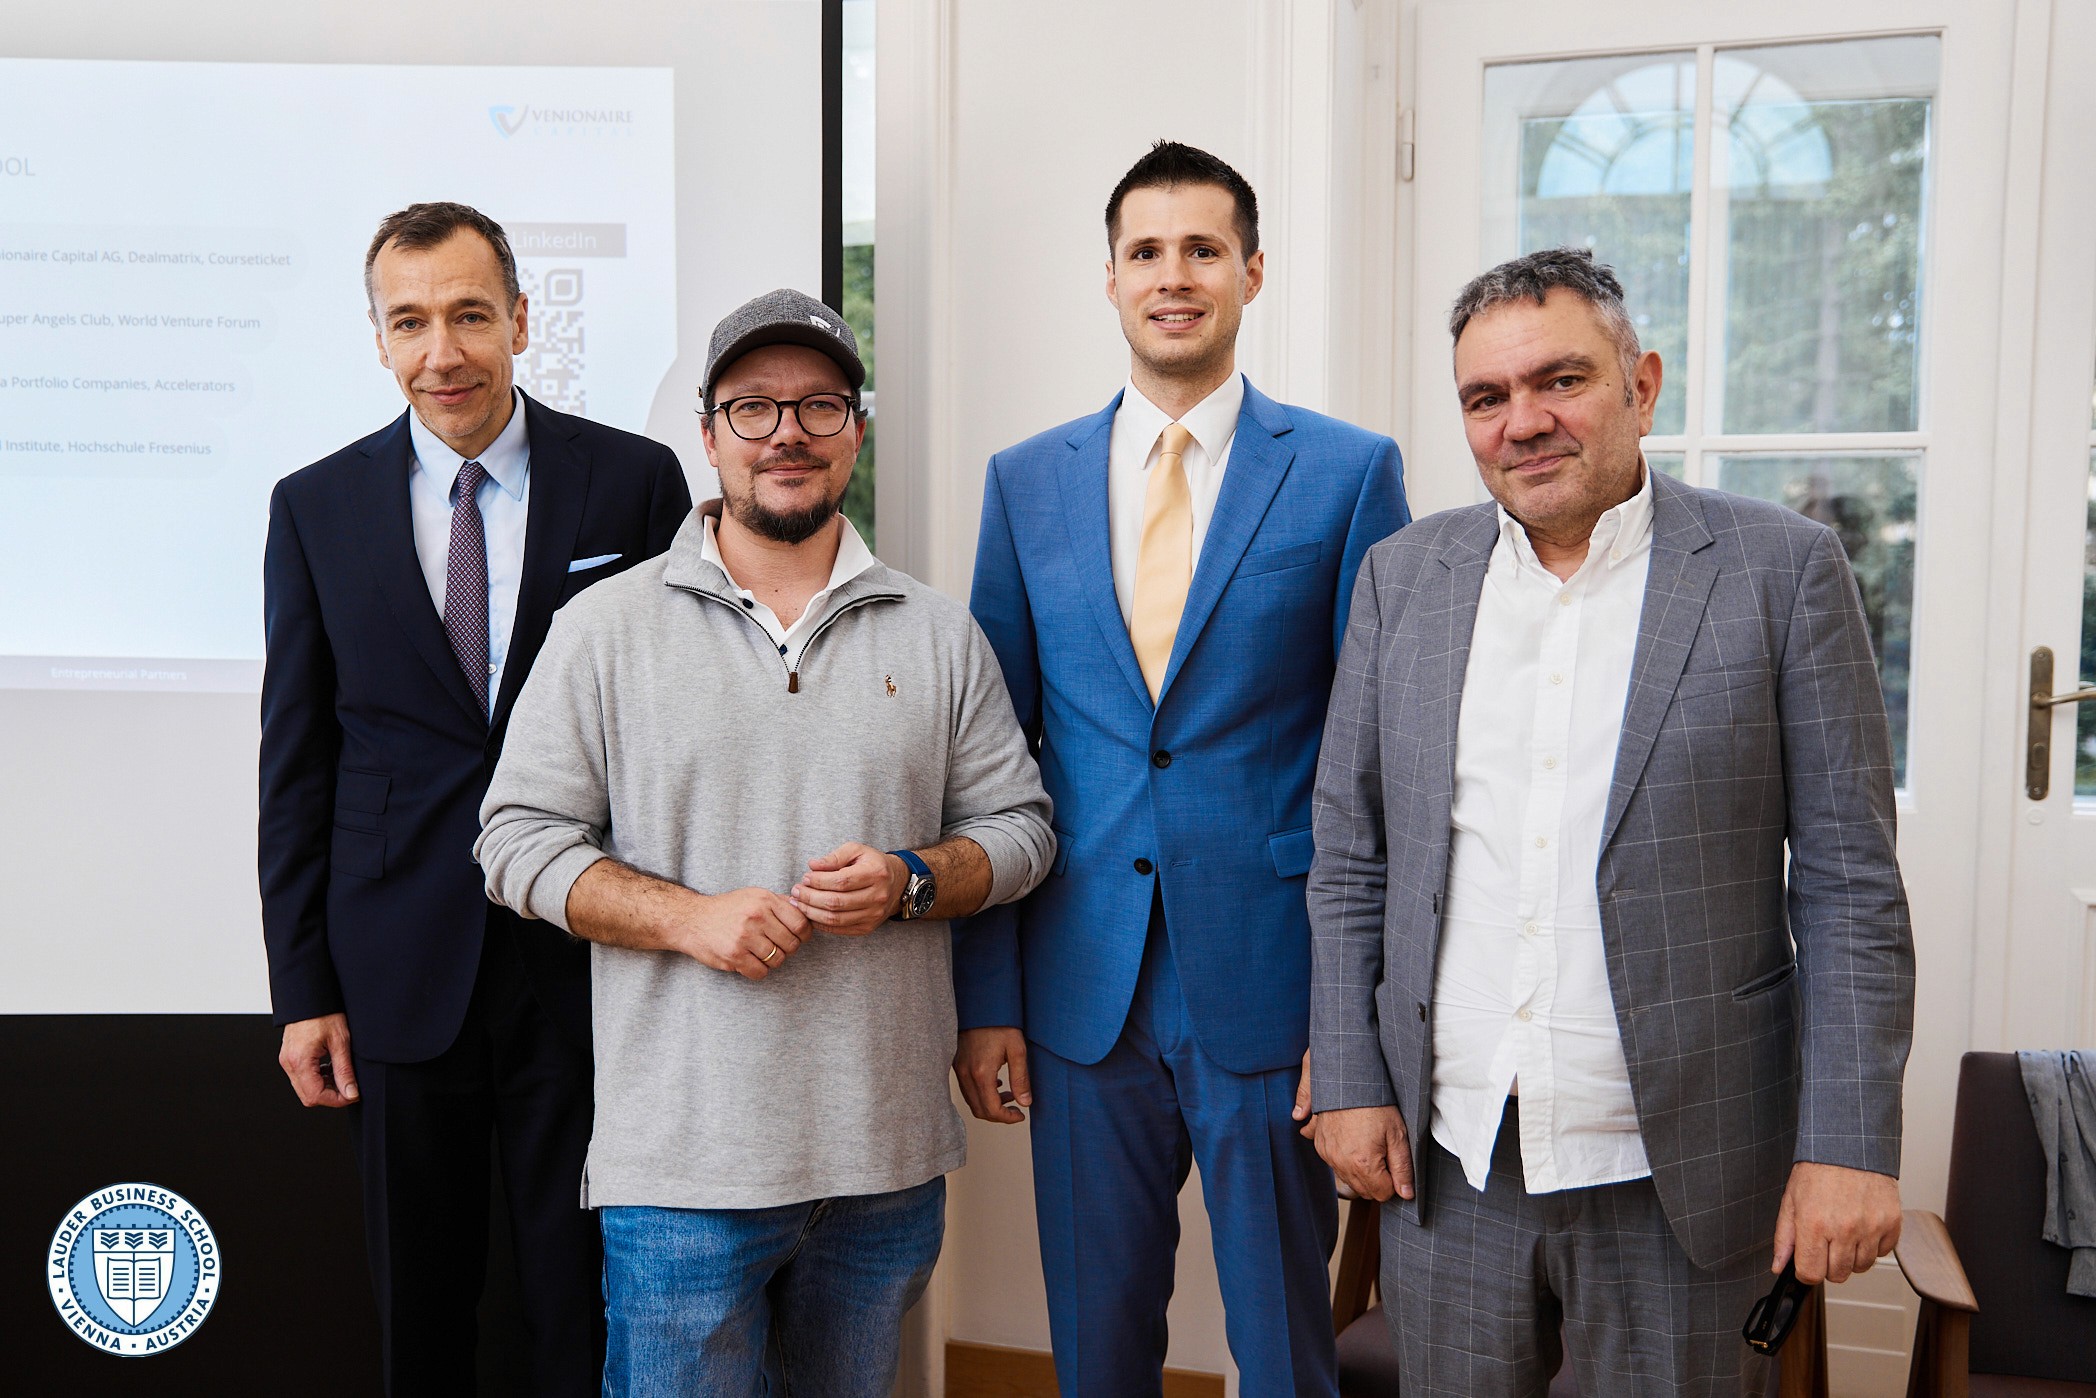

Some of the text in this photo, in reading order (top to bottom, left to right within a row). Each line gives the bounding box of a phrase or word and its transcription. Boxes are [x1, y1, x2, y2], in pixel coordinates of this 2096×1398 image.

[532, 109, 633, 123] VENIONAIRE
[0, 157, 36, 176] OL
[513, 231, 597, 249] LinkedIn
[0, 249, 291, 266] ionaire Capital AG, Dealmatrix, Courseticket
[32, 313, 77, 328] Angels
[80, 313, 114, 327] Club,
[118, 314, 158, 328] World
[161, 315, 213, 328] Venture
[217, 316, 261, 329] Forum
[11, 376, 69, 389] Portfolio
[72, 376, 150, 392] Companies,
[154, 378, 236, 392] Accelerators
[5, 440, 64, 453] Institute,
[68, 440, 145, 455] Hochschule
[149, 442, 212, 455] Fresenius
[51, 667, 187, 681] Entrepreneurial Partners
